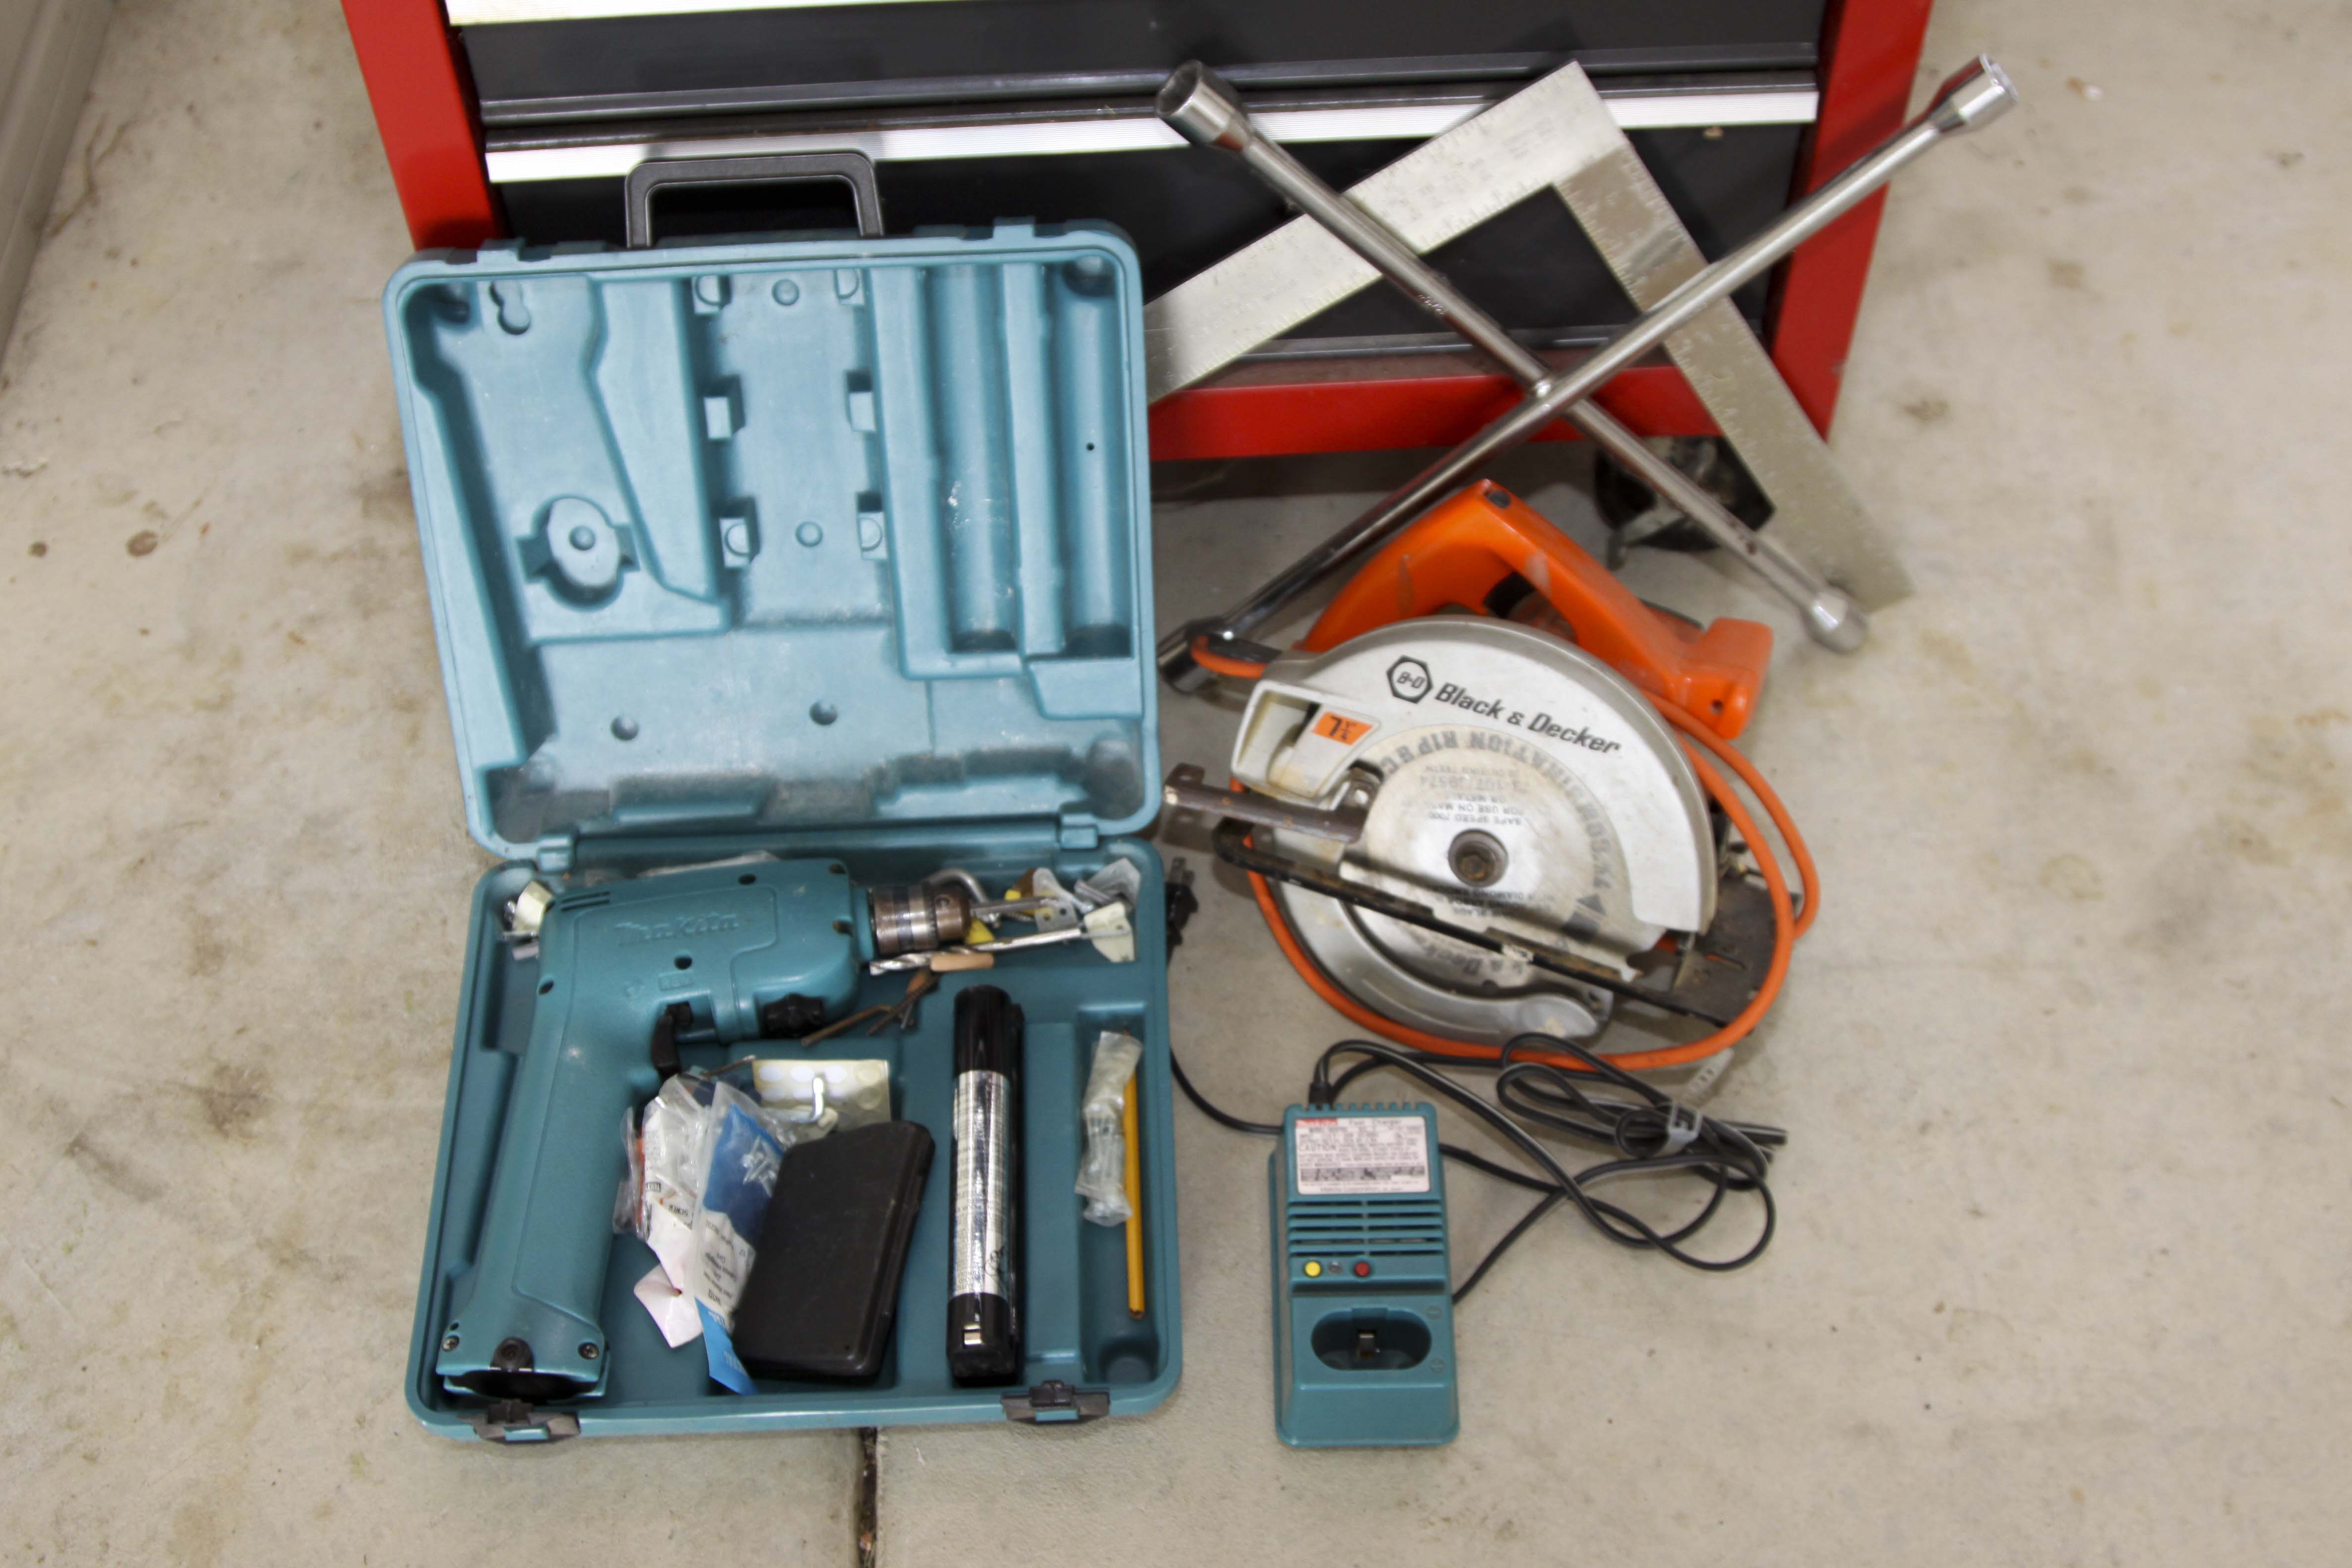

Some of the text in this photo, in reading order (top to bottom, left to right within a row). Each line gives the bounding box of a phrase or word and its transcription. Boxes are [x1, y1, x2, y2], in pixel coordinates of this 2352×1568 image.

[1435, 682, 1621, 753] Black & Decker
[1419, 730, 1459, 755] RIP
[1458, 803, 1474, 812] ON
[1477, 804, 1499, 813] USE
[1455, 814, 1490, 823] SPEED
[1494, 816, 1521, 825] SAFE
